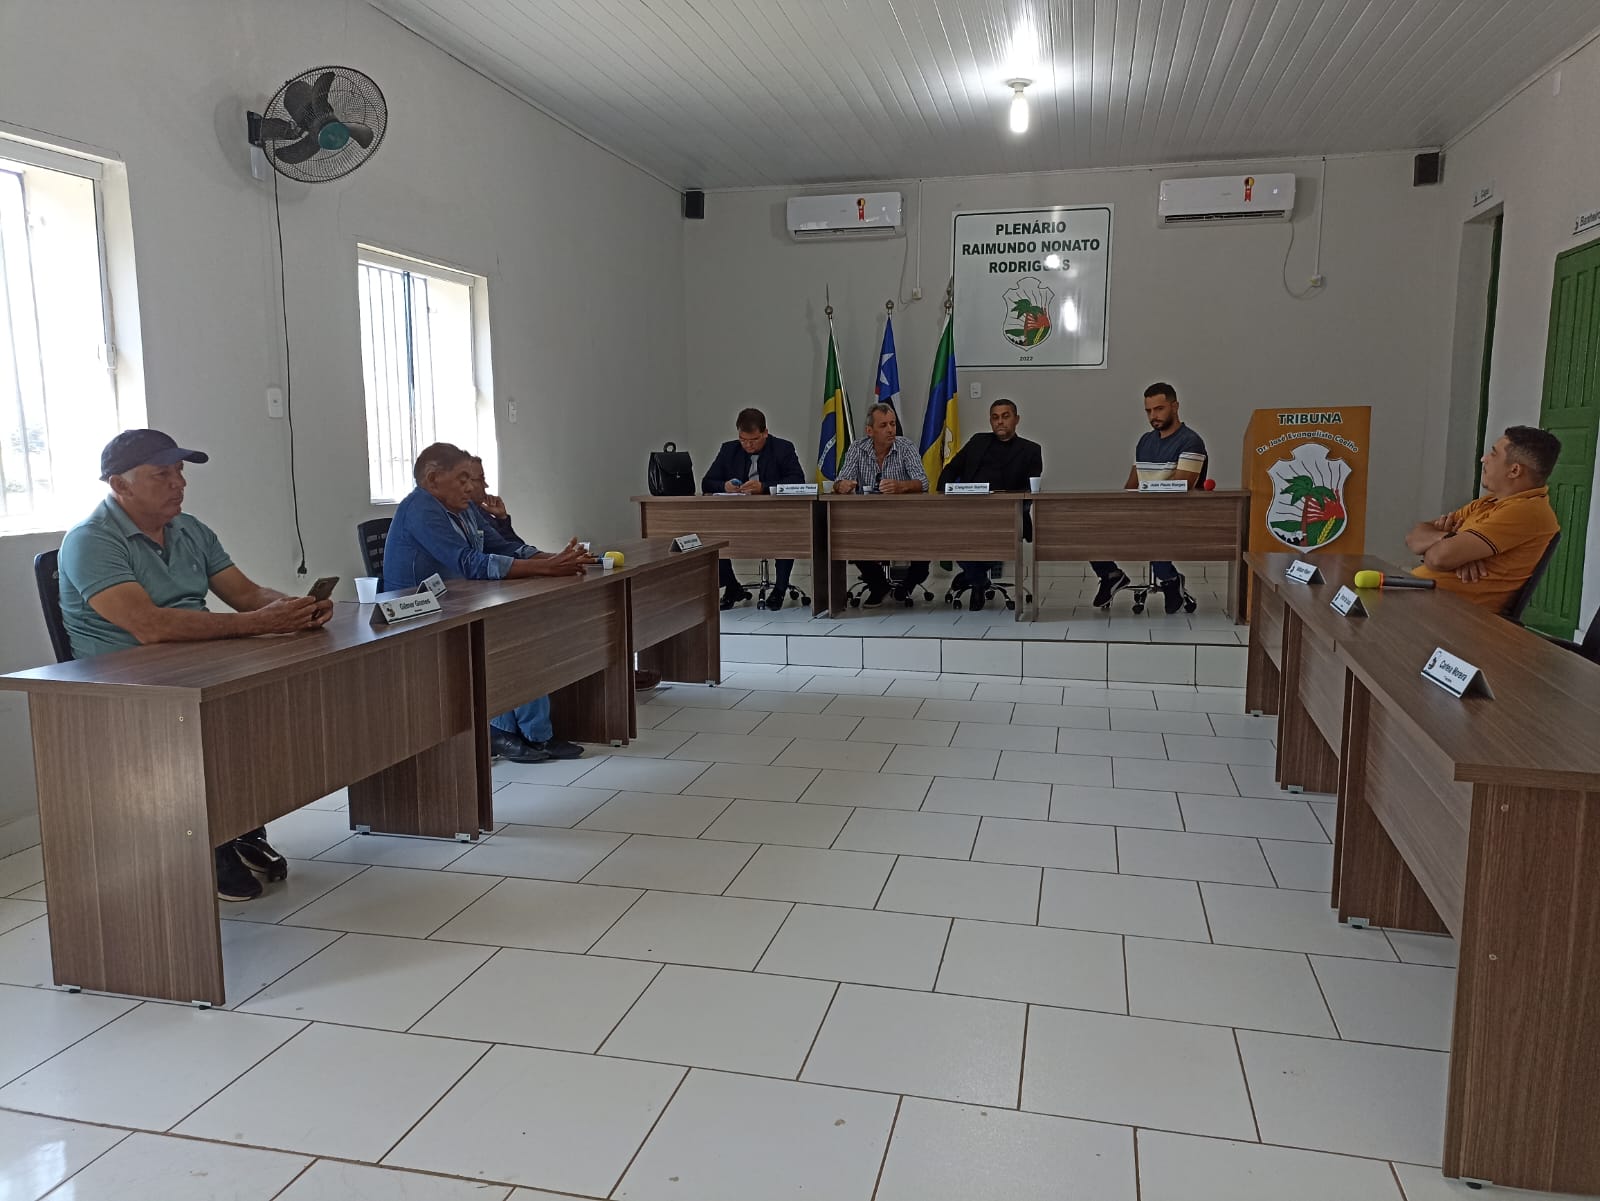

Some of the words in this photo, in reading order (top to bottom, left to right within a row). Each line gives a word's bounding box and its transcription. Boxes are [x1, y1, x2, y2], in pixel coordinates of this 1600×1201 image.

[995, 220, 1067, 236] PLENÁRIO
[962, 241, 1037, 256] RAIMUNDO
[1041, 239, 1100, 253] NONATO
[989, 259, 1071, 274] RODRIGS
[1278, 413, 1342, 425] TRIBUNA
[1256, 446, 1269, 454] Dr.
[1270, 434, 1286, 447] José
[1334, 435, 1358, 452] Coelho
